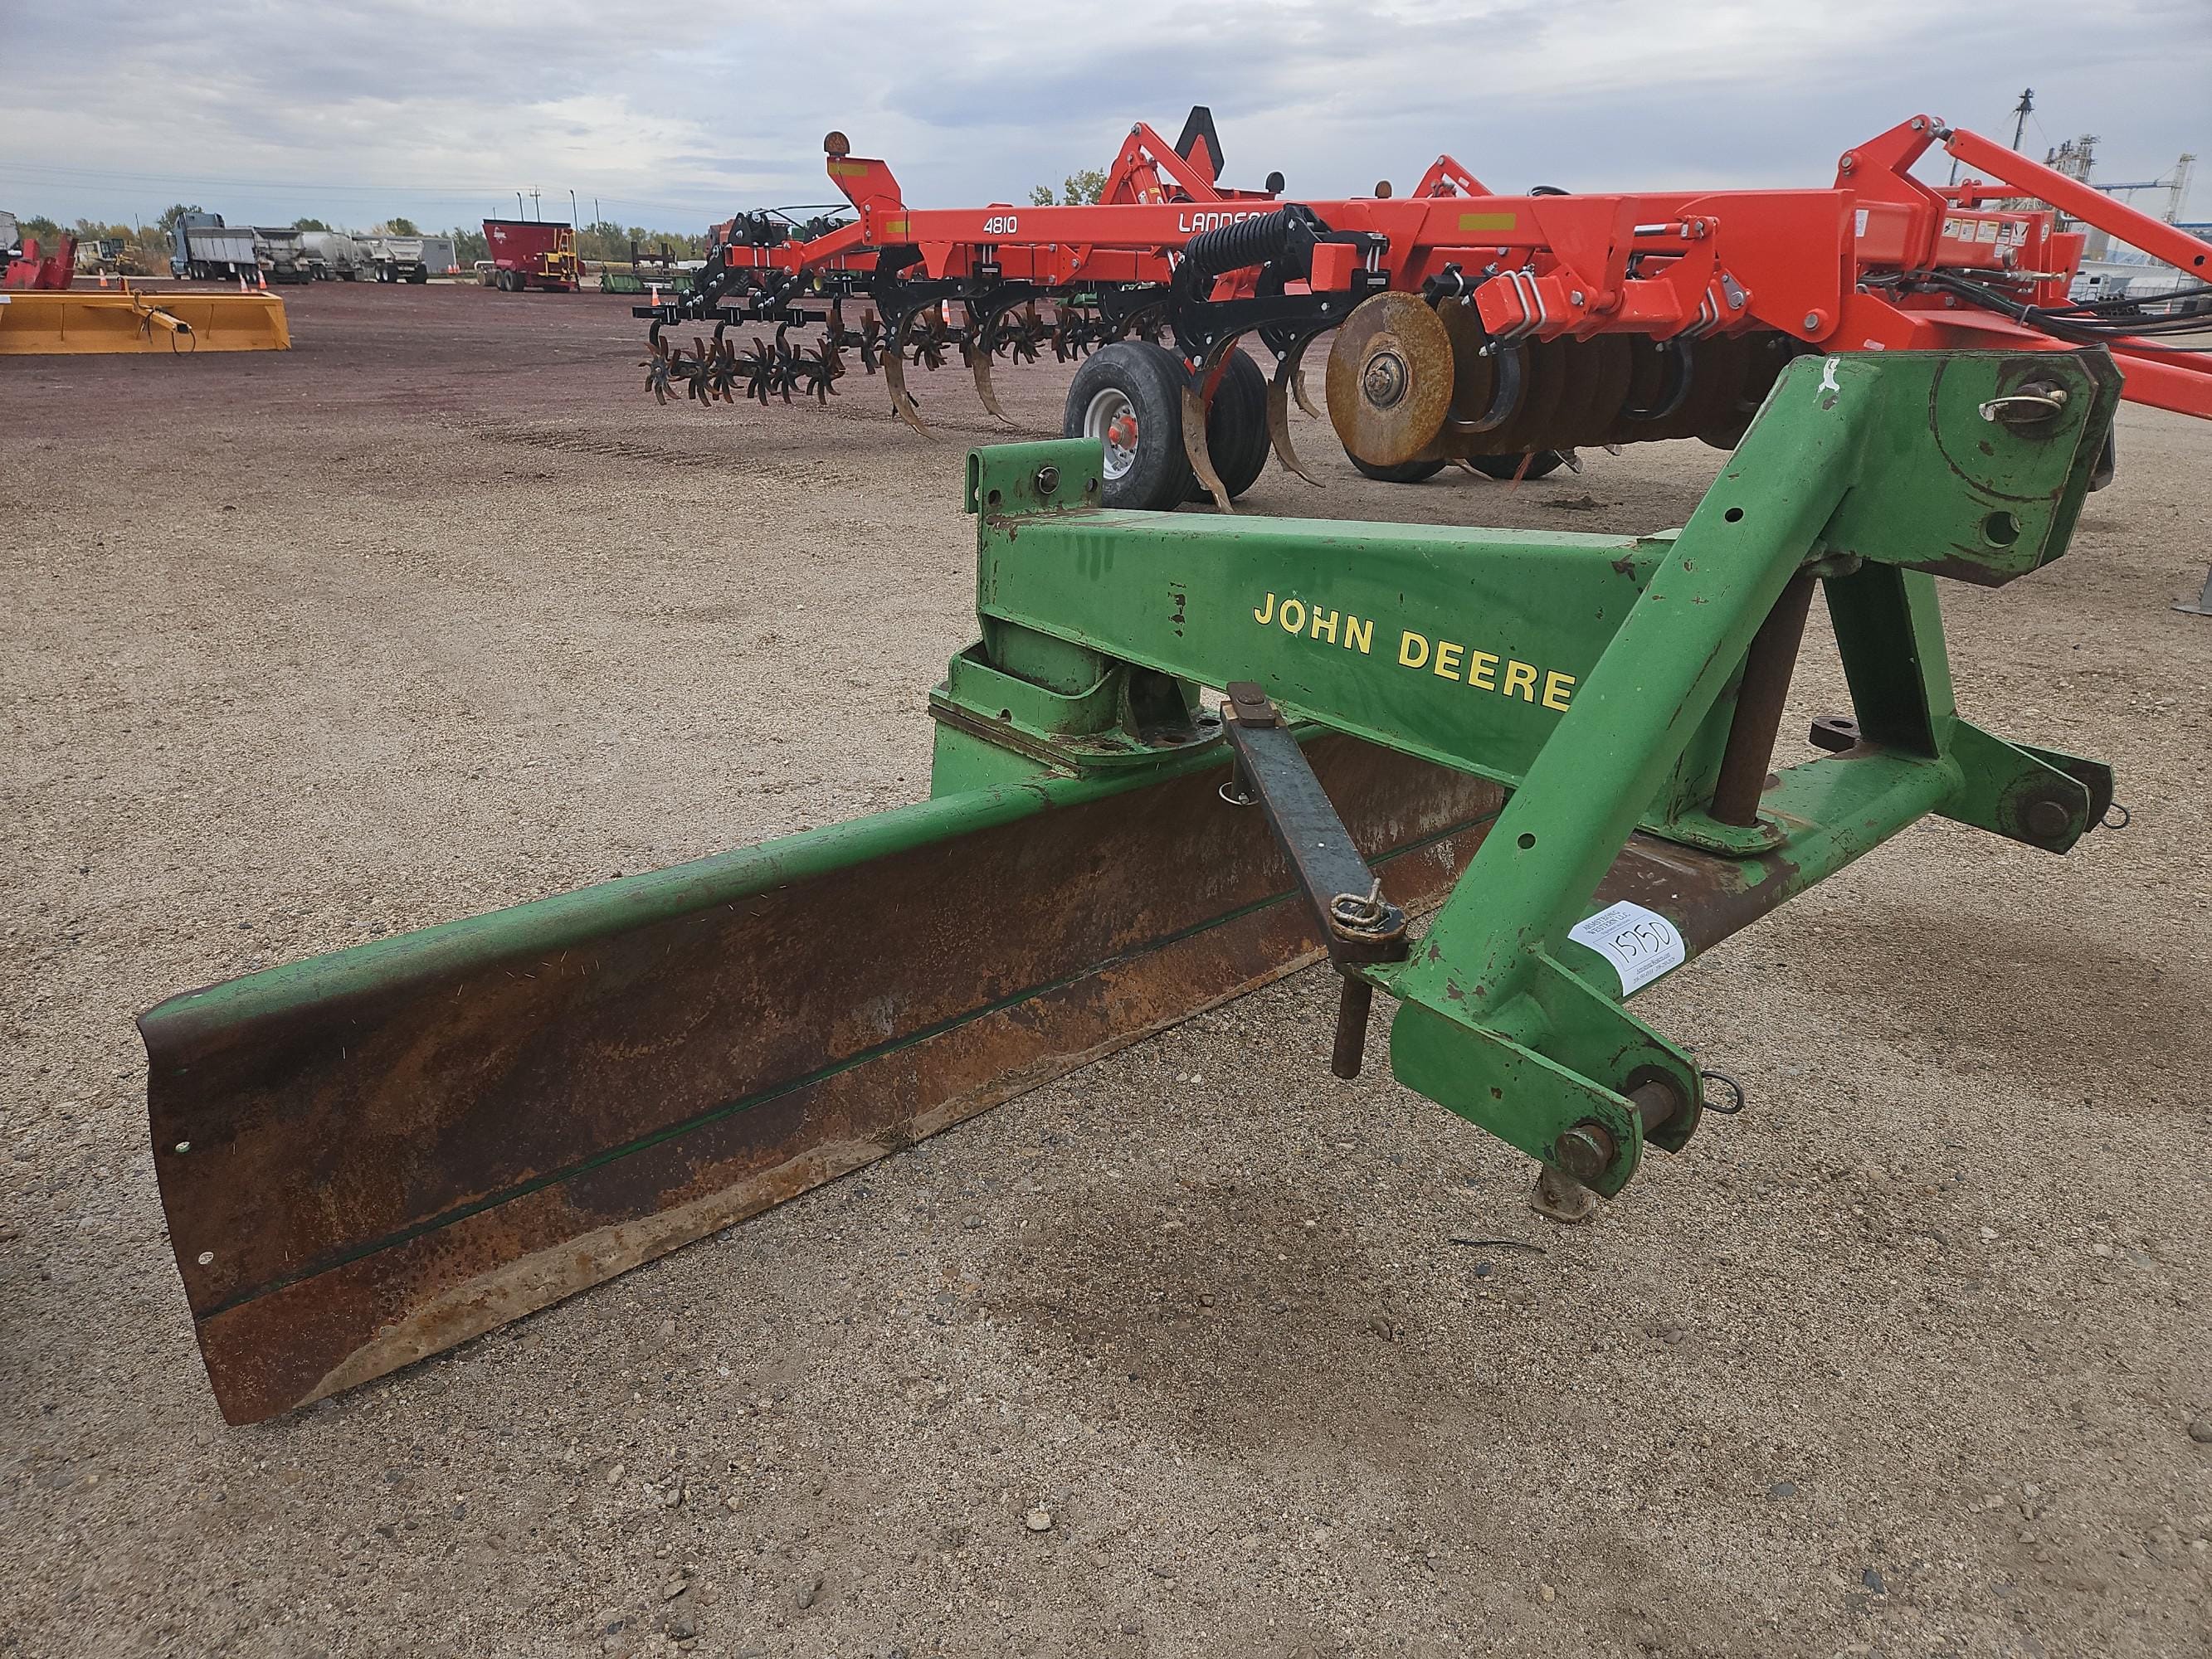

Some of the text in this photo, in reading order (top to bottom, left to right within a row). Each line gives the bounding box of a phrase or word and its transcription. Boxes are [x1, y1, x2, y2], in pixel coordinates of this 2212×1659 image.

[983, 216, 1017, 234] 4810
[1254, 591, 1576, 713] JOHN DEERE
[1608, 922, 1670, 963] 15750
